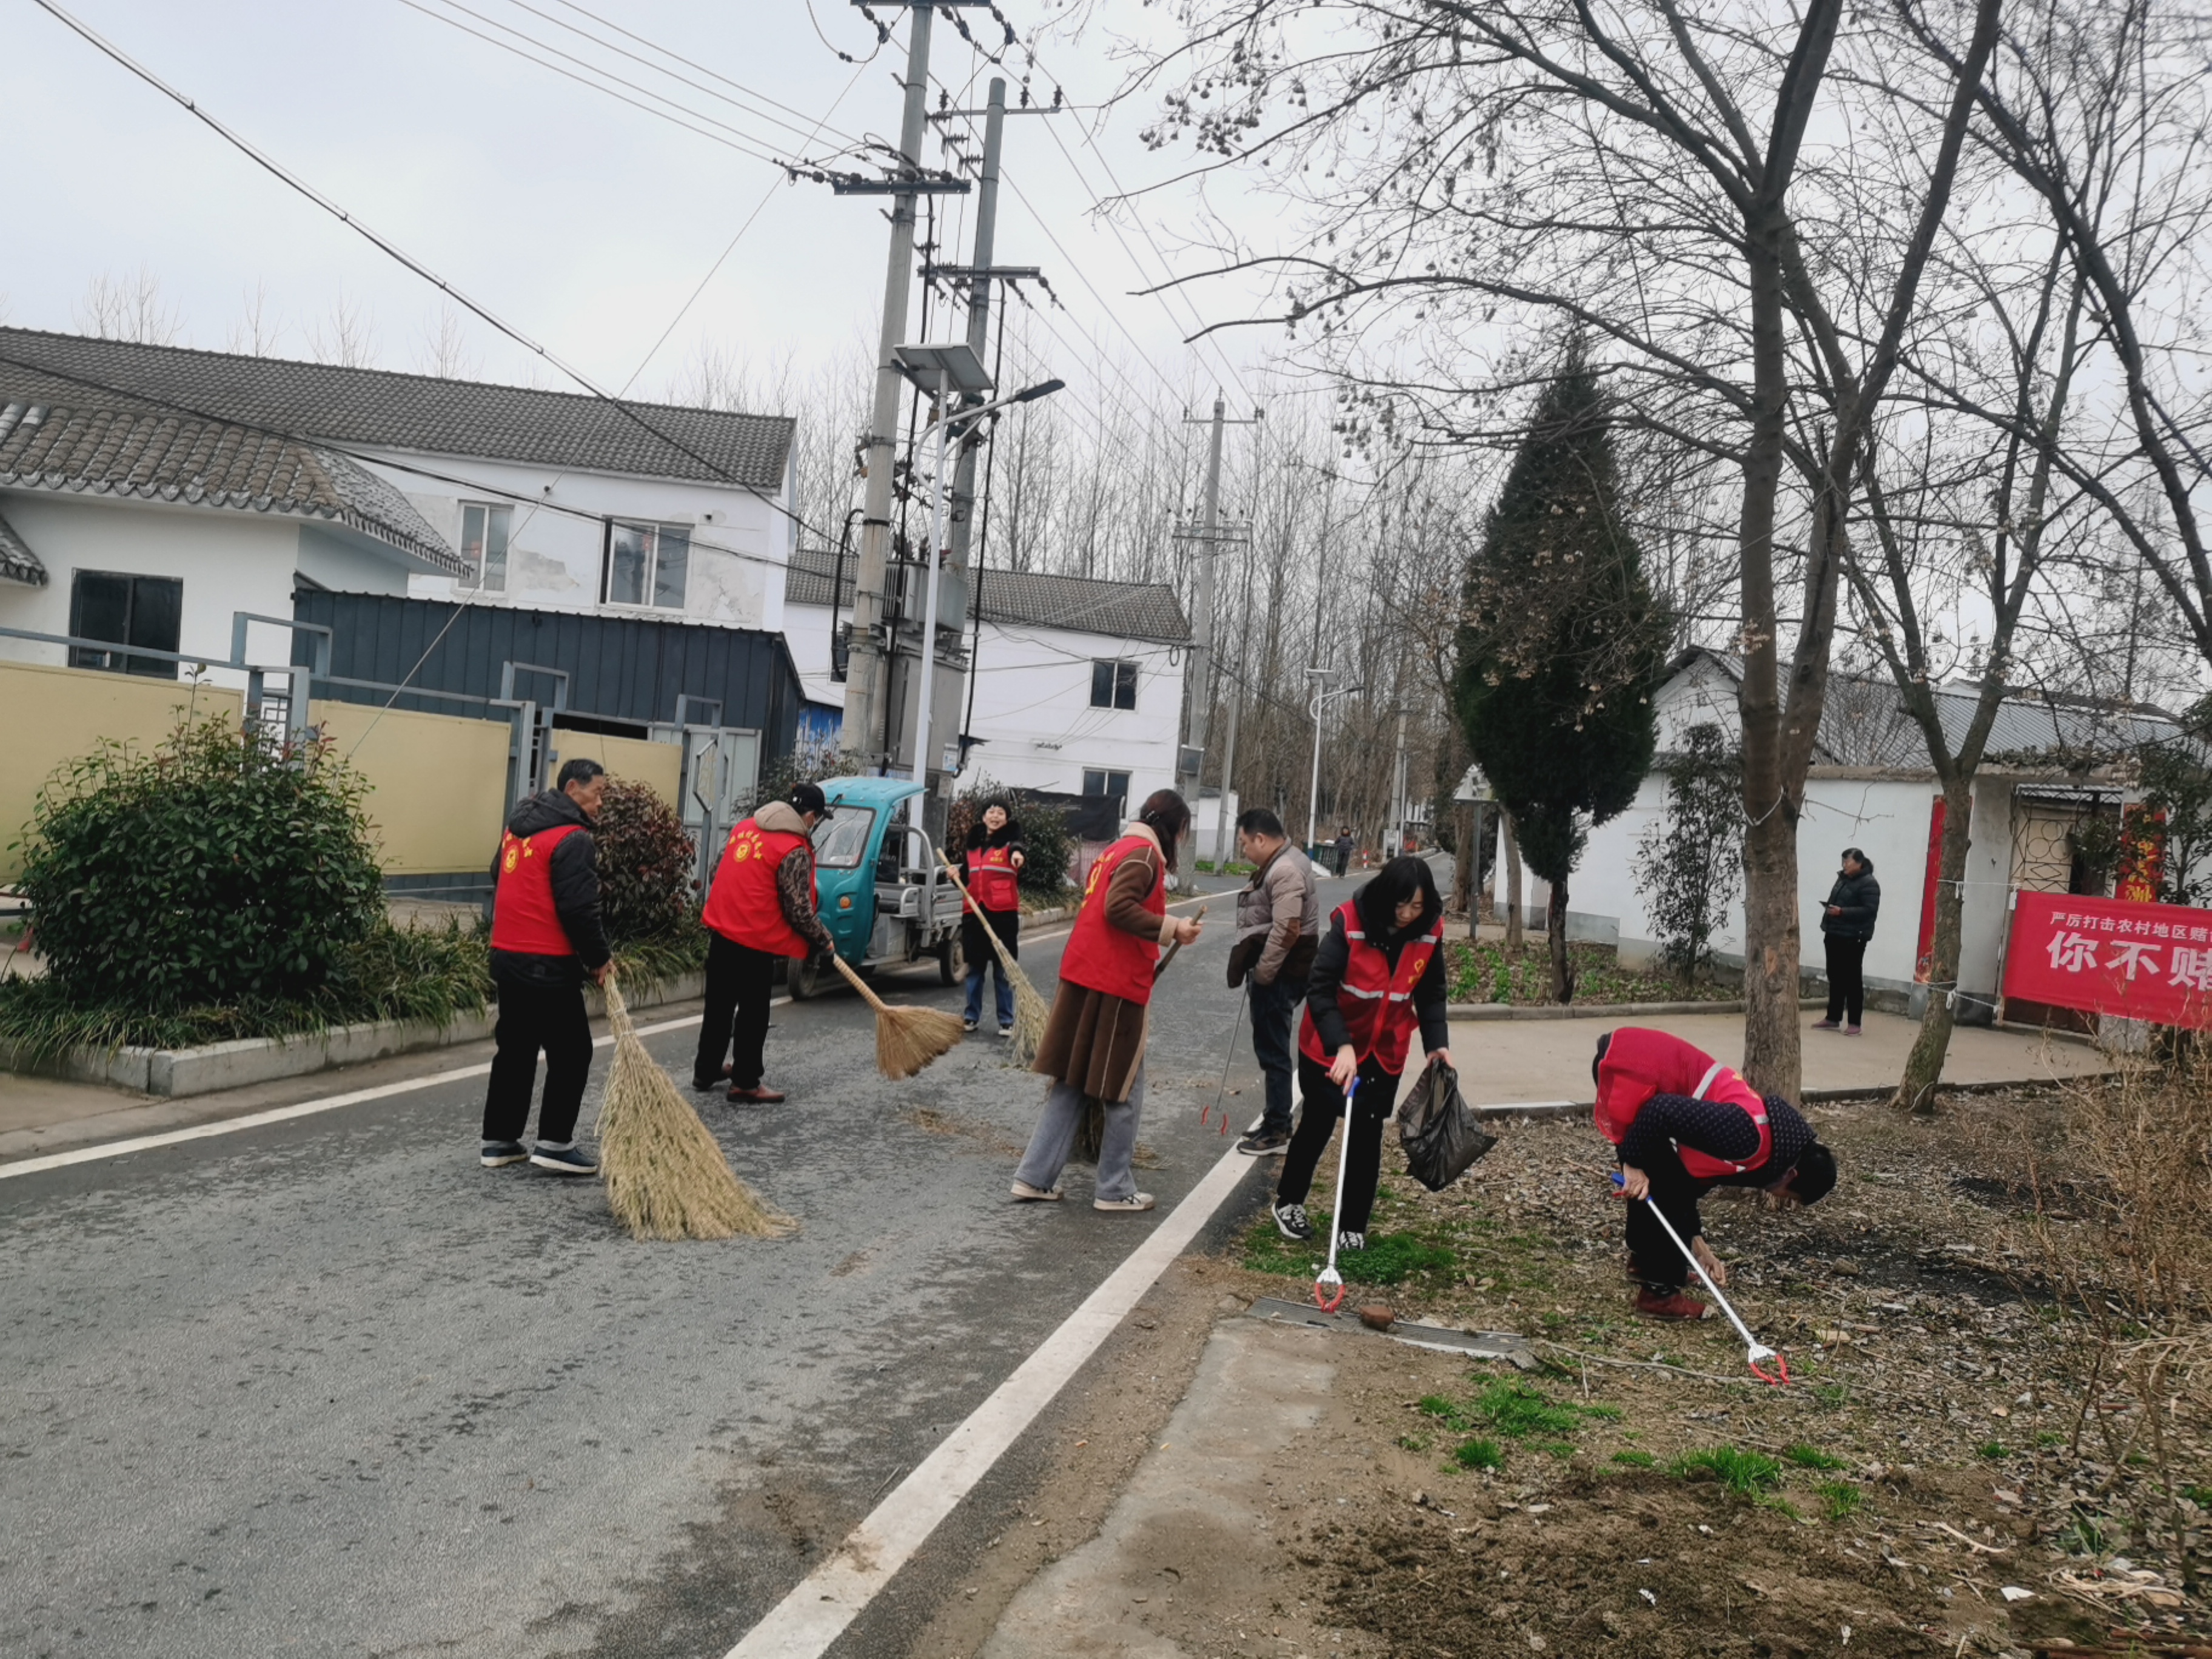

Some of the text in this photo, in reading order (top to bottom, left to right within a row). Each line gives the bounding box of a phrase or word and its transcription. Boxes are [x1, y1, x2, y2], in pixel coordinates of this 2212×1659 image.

[2050, 911, 2212, 942] 严厉打击农村地区赌
